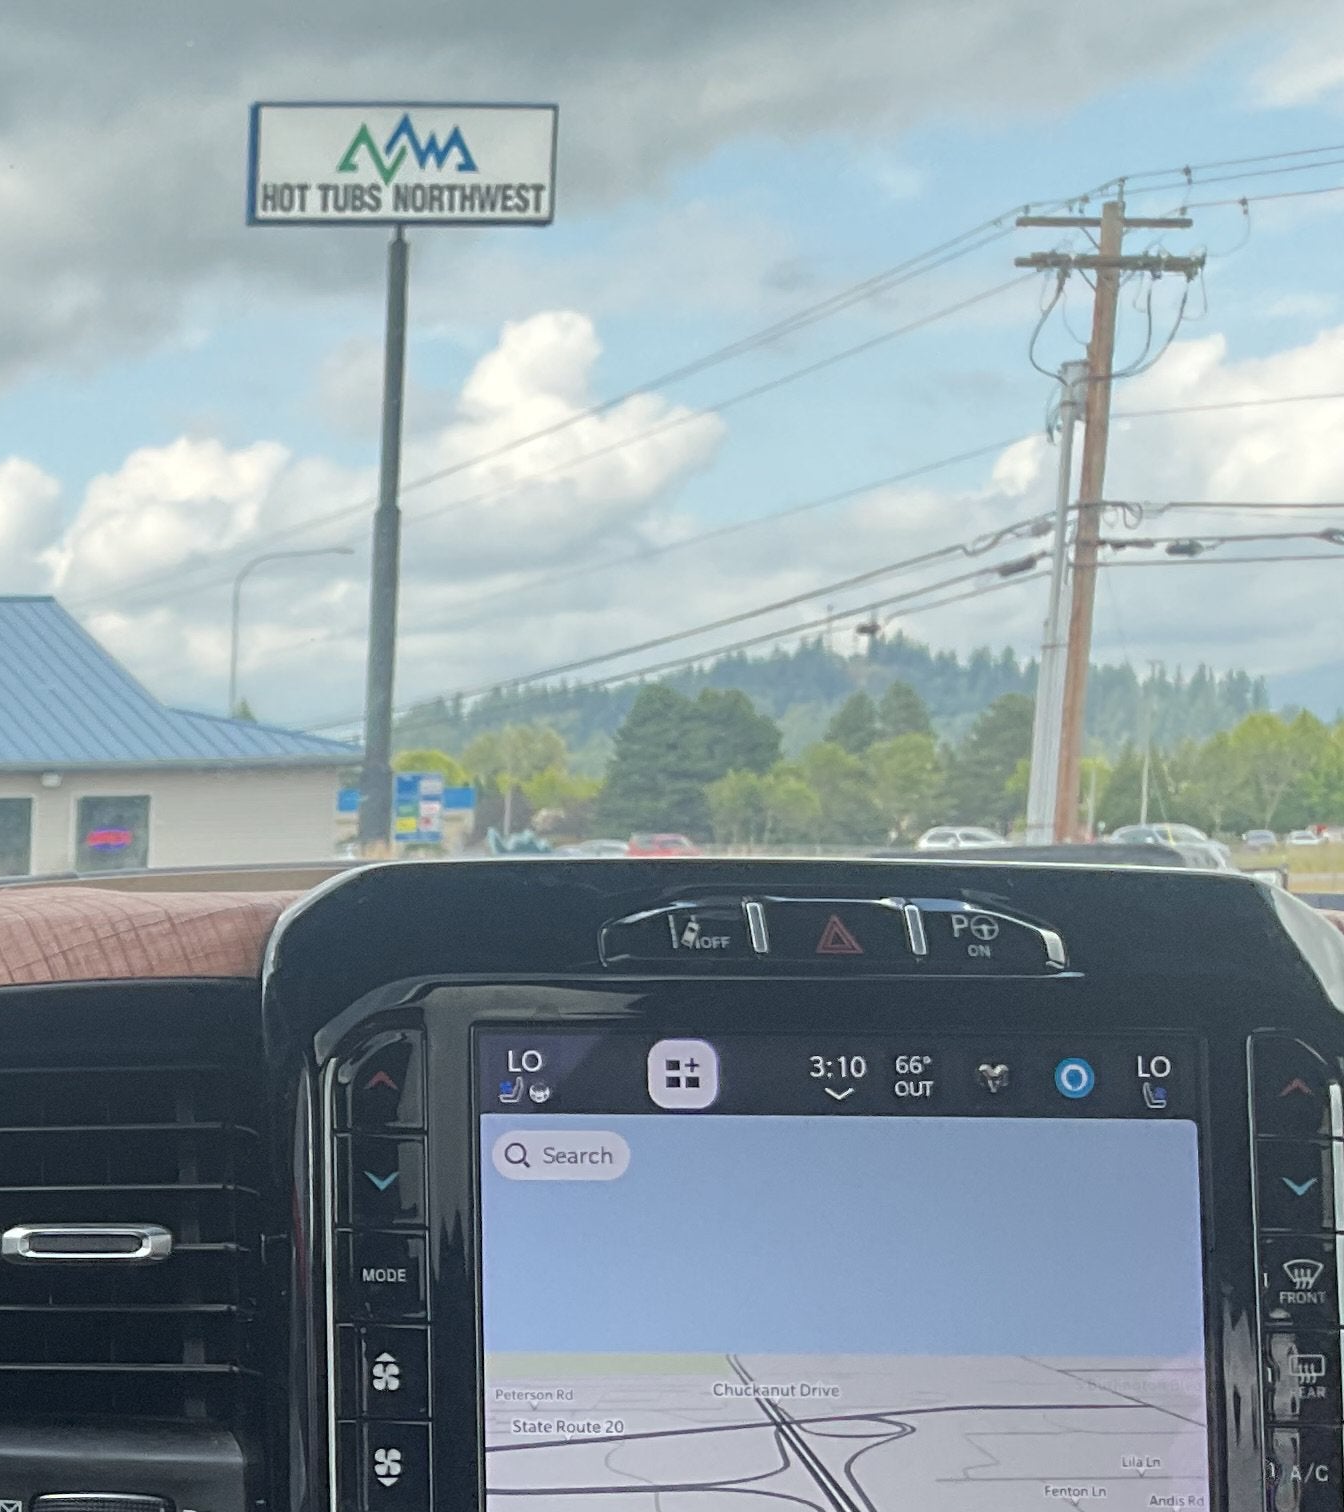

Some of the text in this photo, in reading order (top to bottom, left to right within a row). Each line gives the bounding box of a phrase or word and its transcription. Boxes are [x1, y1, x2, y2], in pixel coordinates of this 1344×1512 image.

[261, 183, 546, 213] HOT TUBS NORTHWEST
[700, 936, 730, 948] OFF
[509, 1050, 542, 1072] LO
[810, 1056, 866, 1078] 3:10
[1138, 1056, 1170, 1077] LO
[895, 1081, 933, 1096] OUT
[543, 1146, 613, 1164] Search
[363, 1269, 406, 1282] MODE
[1280, 1291, 1326, 1303] FRONT
[495, 1389, 573, 1401] Peterson Rd
[712, 1383, 840, 1397] Chuckanut Drive
[512, 1420, 624, 1434] State Route 20
[1121, 1457, 1160, 1468] Lila Ln
[1290, 1464, 1328, 1483] A/C
[1044, 1486, 1106, 1498] Fenton Ln
[1150, 1495, 1205, 1507] Andis Rd
